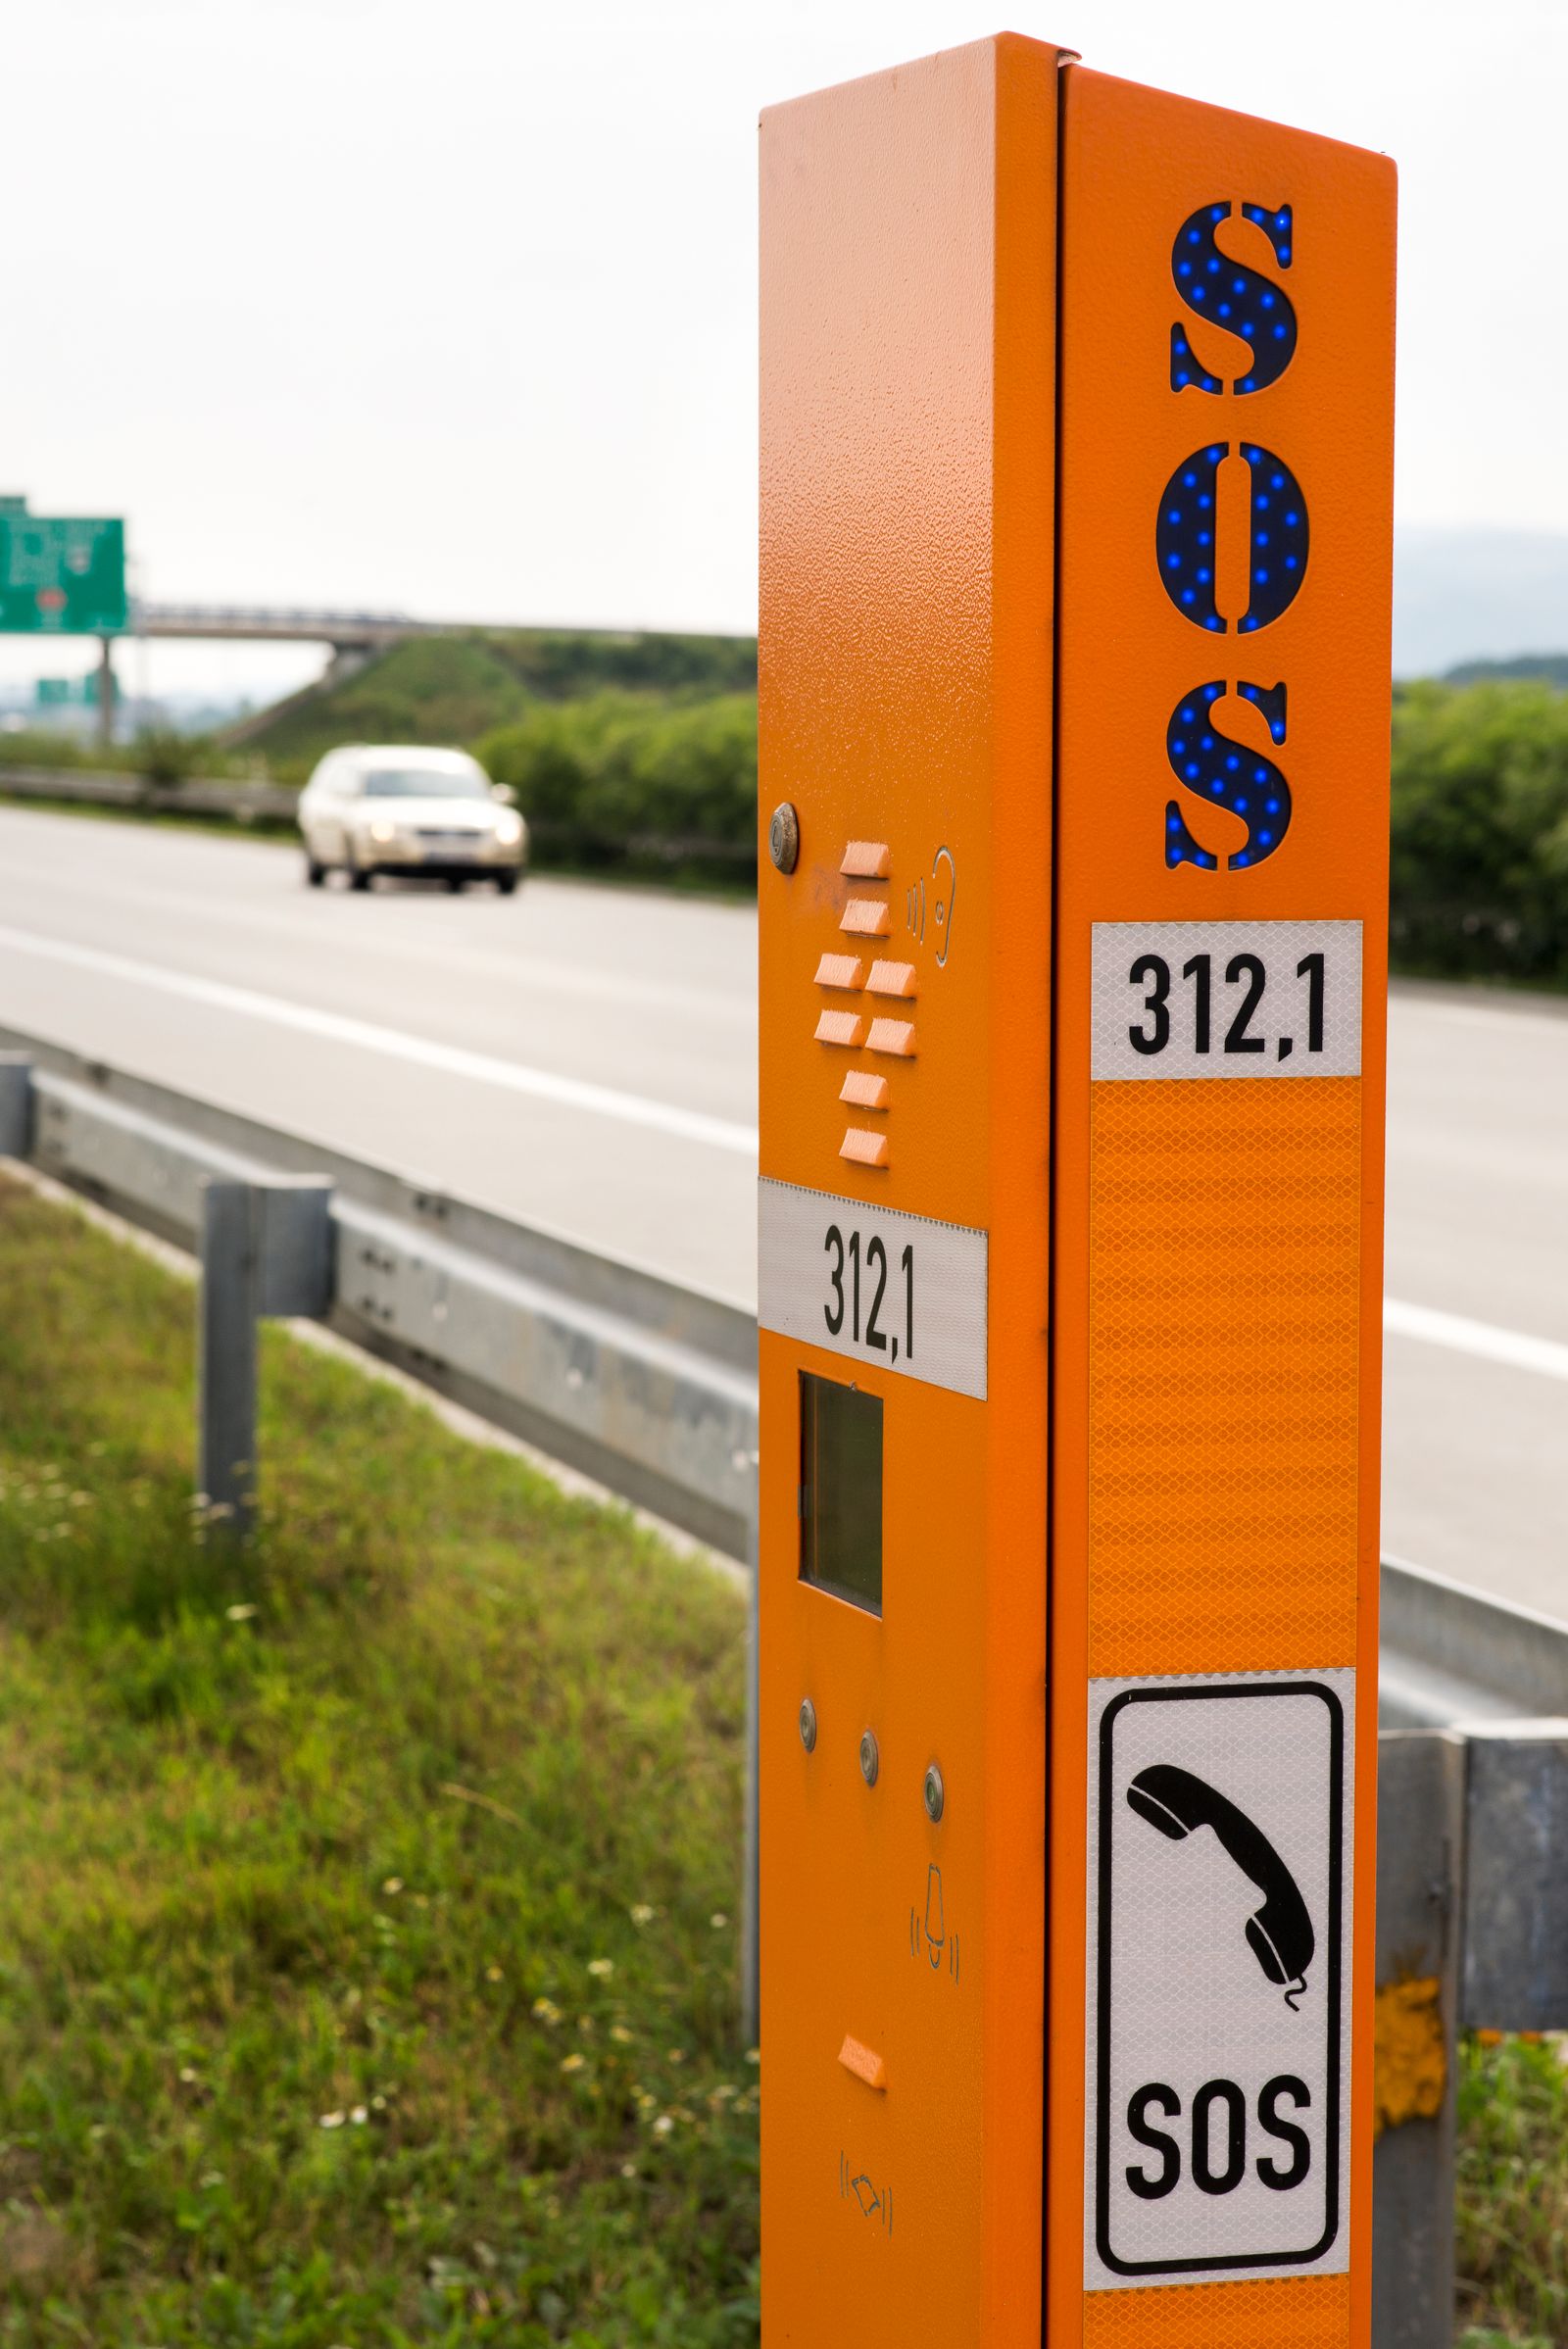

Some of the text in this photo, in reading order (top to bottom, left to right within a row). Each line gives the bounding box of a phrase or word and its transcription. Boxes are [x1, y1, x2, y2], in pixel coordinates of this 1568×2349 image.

[1156, 201, 1310, 873] SOS
[1128, 953, 1325, 1063] 312,1
[824, 1224, 913, 1364] 312,1
[1125, 2075, 1311, 2200] SOS
